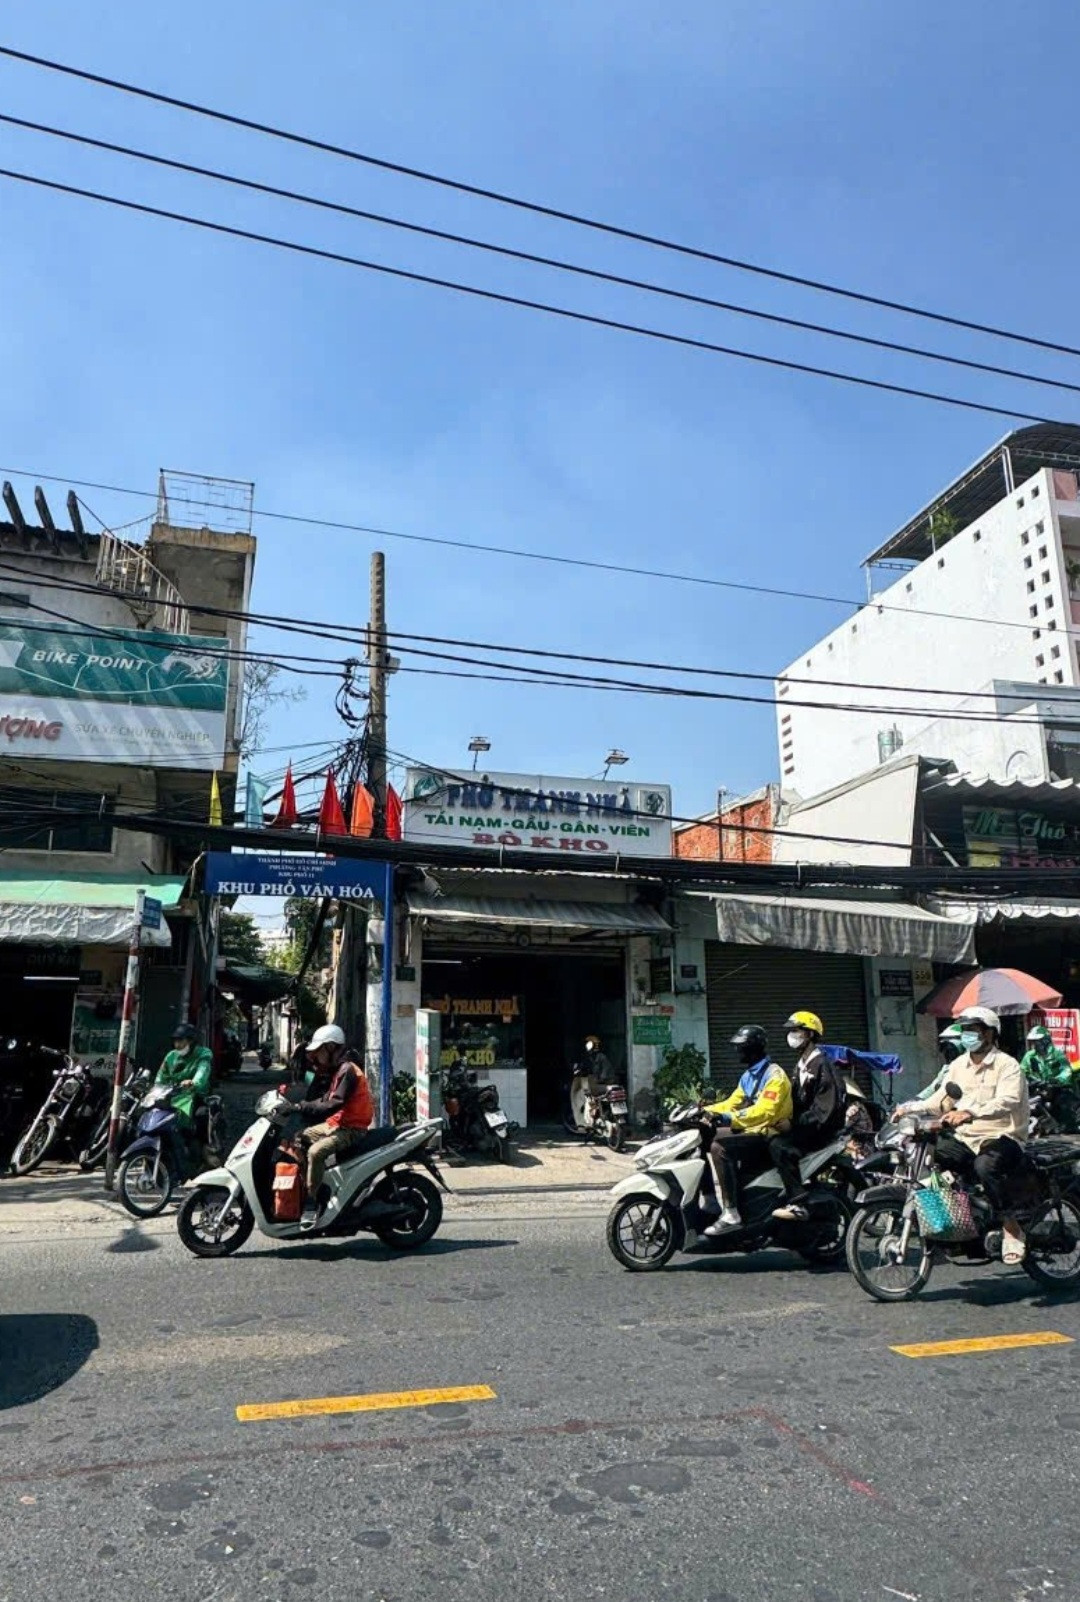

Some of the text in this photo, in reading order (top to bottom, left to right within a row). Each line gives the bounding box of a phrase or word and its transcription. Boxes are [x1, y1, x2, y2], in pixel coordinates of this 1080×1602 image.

[32, 650, 147, 671] BIKE POINT
[472, 830, 609, 851] BÒ KHO
[217, 878, 375, 898] KHU PHỐ VĂN HÓA
